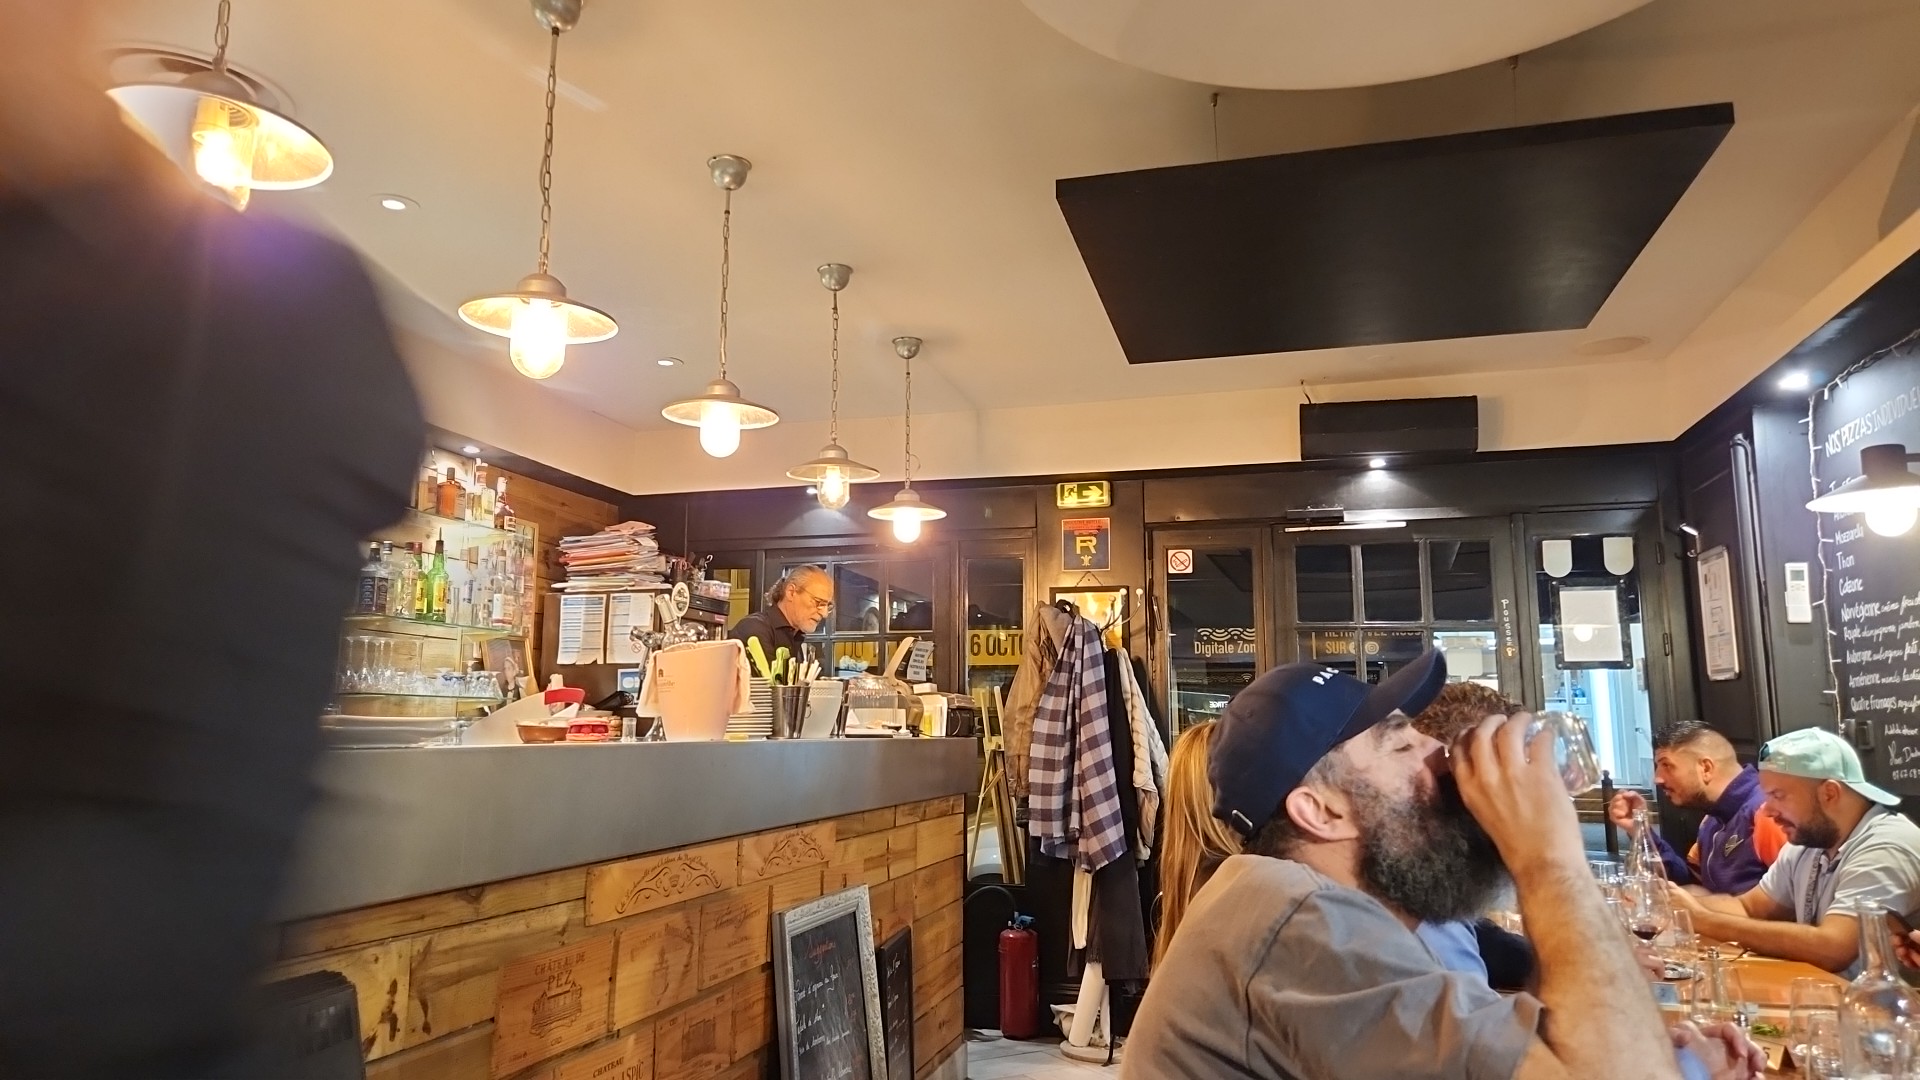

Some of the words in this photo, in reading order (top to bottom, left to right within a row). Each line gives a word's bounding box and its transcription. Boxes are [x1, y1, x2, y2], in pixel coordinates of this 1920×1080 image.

[1825, 429, 1841, 458] NOS
[1841, 412, 1872, 448] PIZZAS
[1194, 640, 1234, 658] Digitale
[1325, 641, 1347, 654] SUR
[547, 969, 573, 991] PEZ
[592, 1056, 625, 1078] CHATEAU
